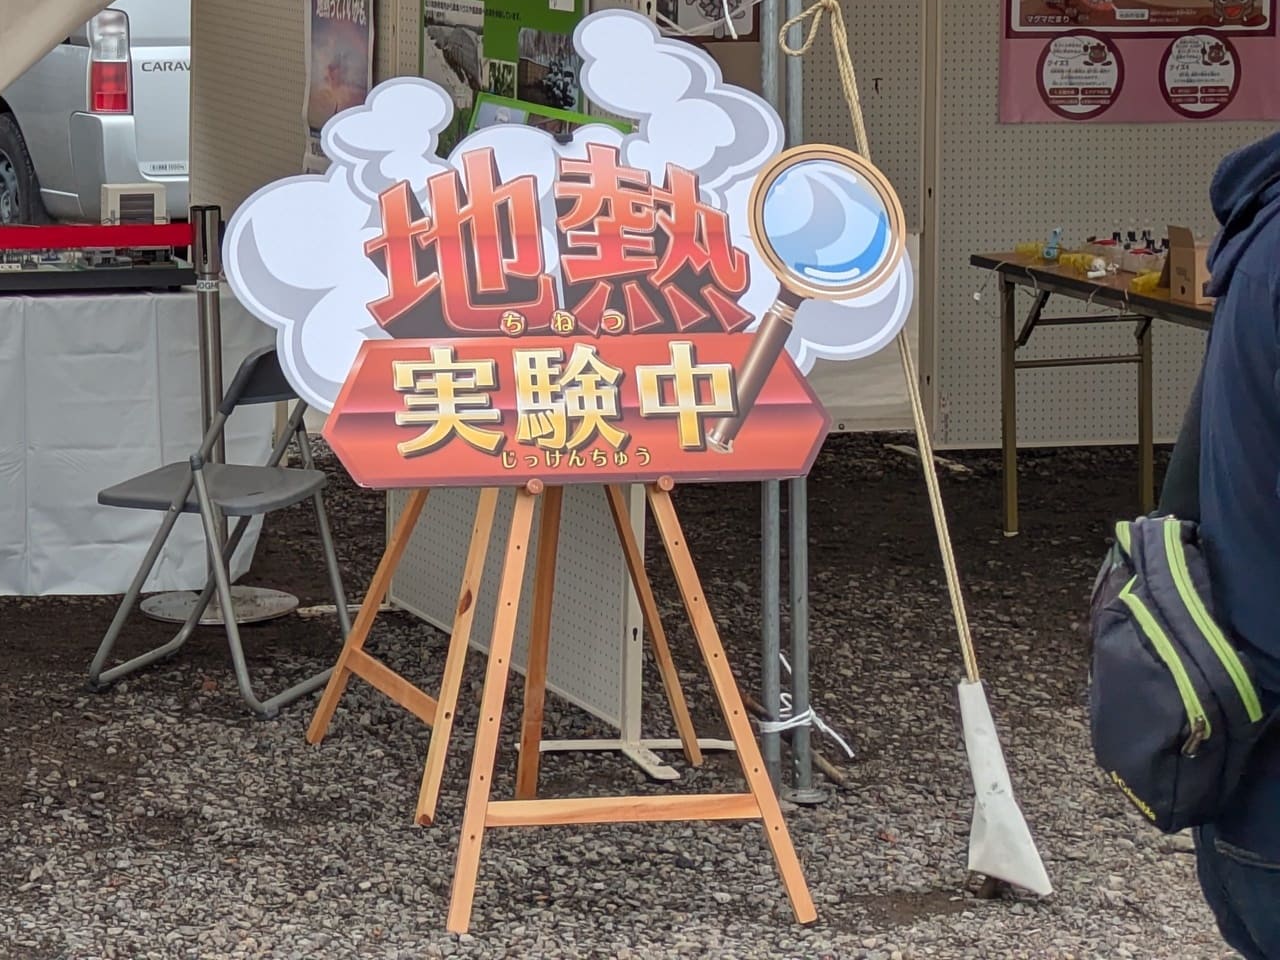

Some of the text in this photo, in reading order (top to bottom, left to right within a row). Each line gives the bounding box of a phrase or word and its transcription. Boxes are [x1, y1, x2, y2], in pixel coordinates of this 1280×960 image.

[365, 142, 756, 336] 地熱
[501, 312, 624, 335] ちねつ
[392, 340, 738, 457] 実験中
[501, 447, 652, 469] じっけんちゅう
